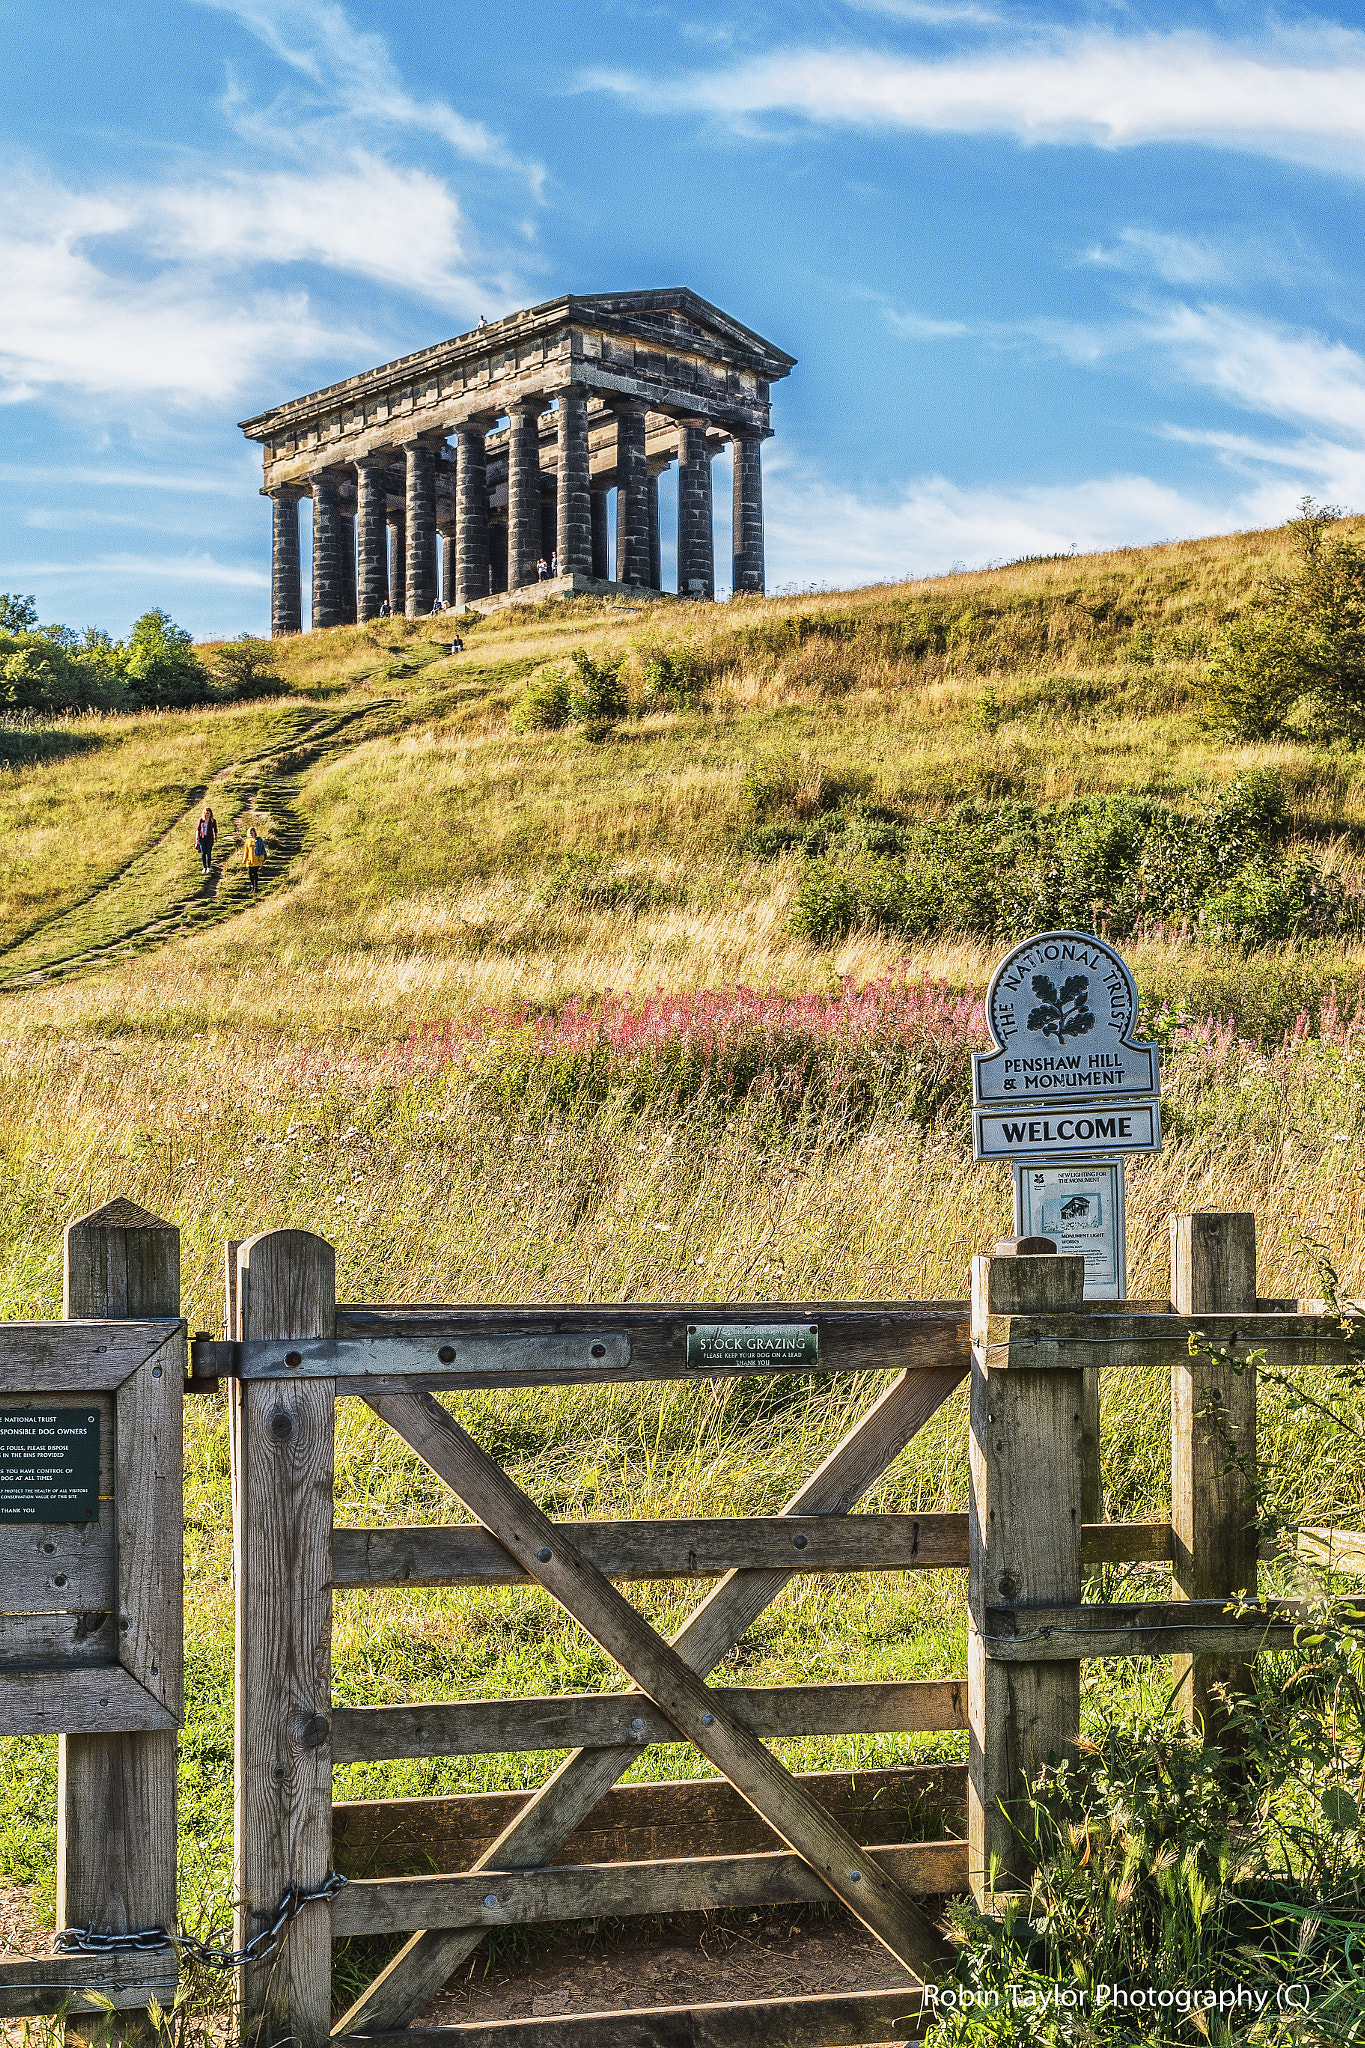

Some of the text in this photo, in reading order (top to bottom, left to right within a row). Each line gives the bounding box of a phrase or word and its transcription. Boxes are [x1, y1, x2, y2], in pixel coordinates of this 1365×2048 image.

[999, 944, 1123, 1040] THE NATIONAL TRUST
[1004, 1053, 1122, 1074] PENSHAW HILL
[1003, 1070, 1125, 1091] & MONUMENT
[1002, 1117, 1132, 1143] WELCOME
[700, 1338, 806, 1350] STOCK GRAZING
[0, 1428, 36, 1436] SPONSIBLE
